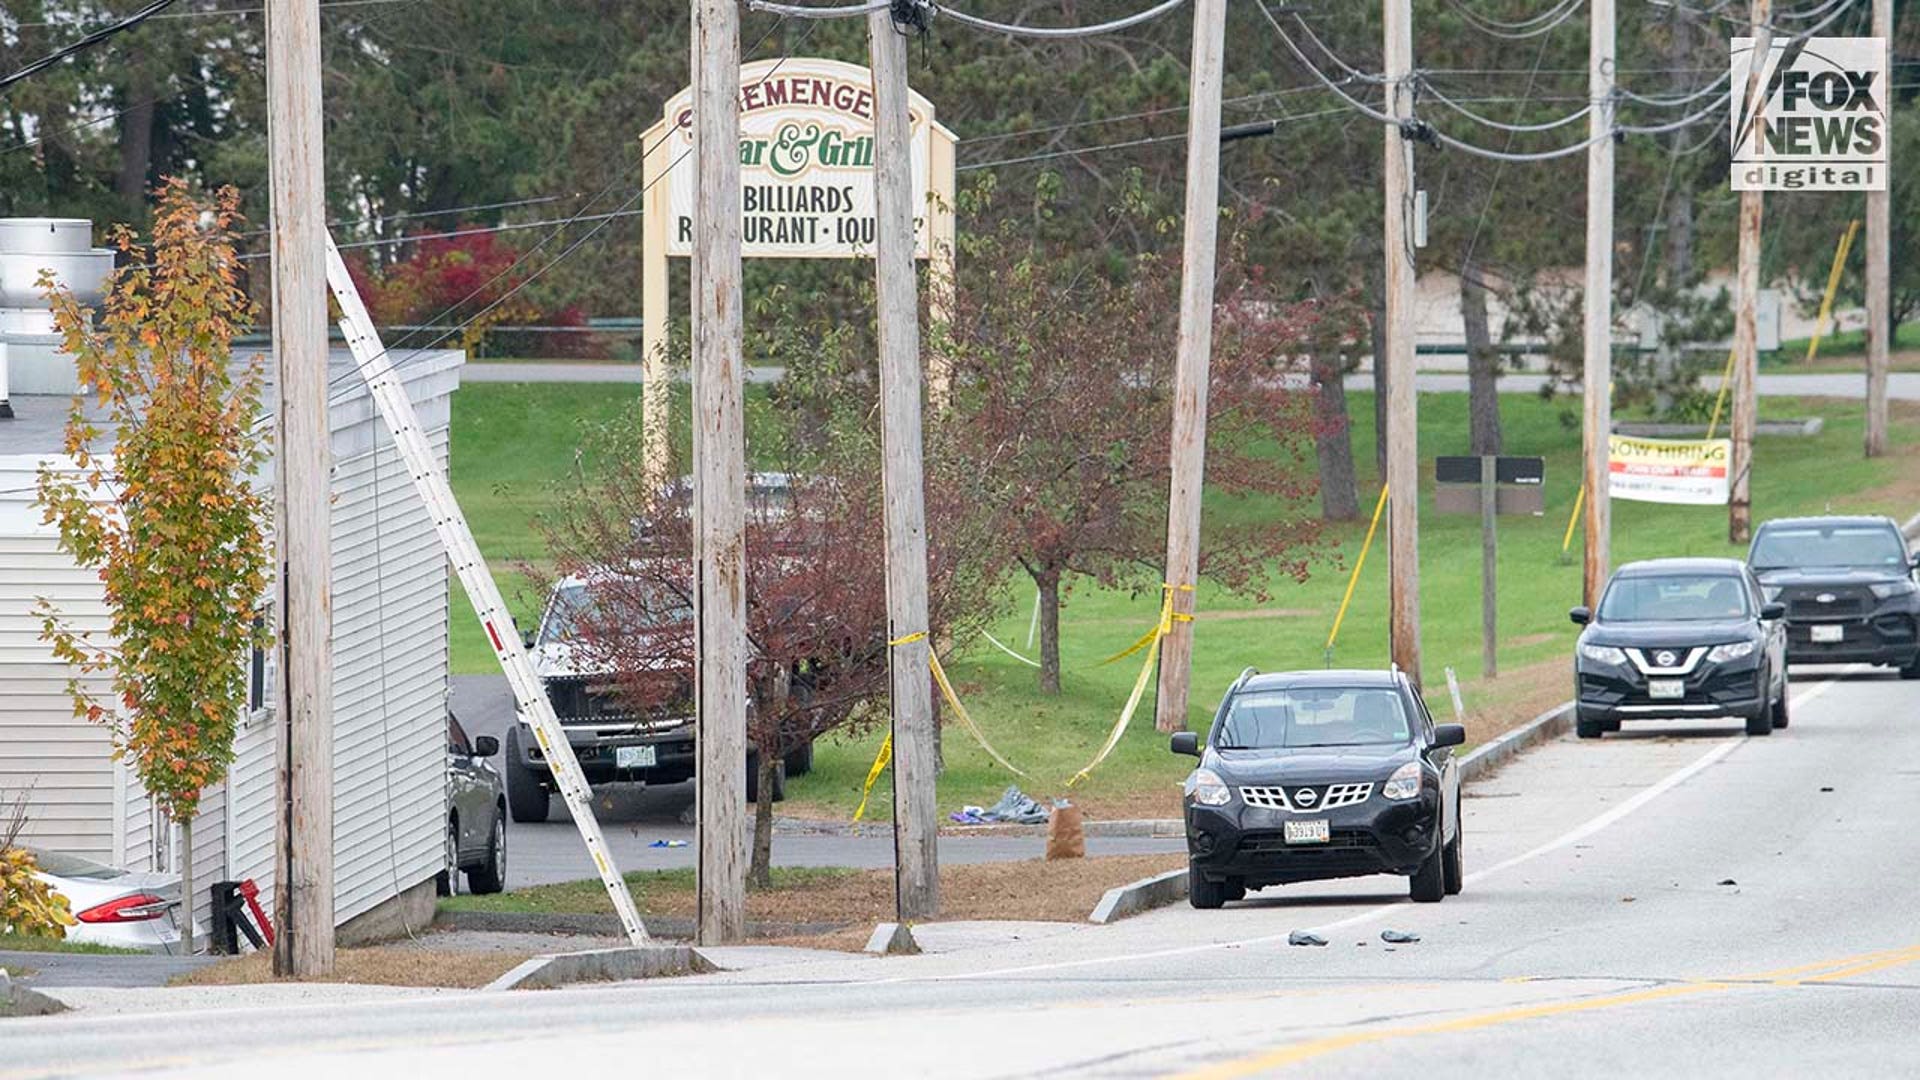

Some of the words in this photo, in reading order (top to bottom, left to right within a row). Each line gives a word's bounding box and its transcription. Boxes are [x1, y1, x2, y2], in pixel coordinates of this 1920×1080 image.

[739, 140, 768, 166] ar
[770, 124, 819, 175] &
[818, 131, 874, 166] Gril
[743, 186, 853, 213] BILLIARDS
[679, 216, 819, 244] RURANT
[1656, 444, 1726, 460] HIRING
